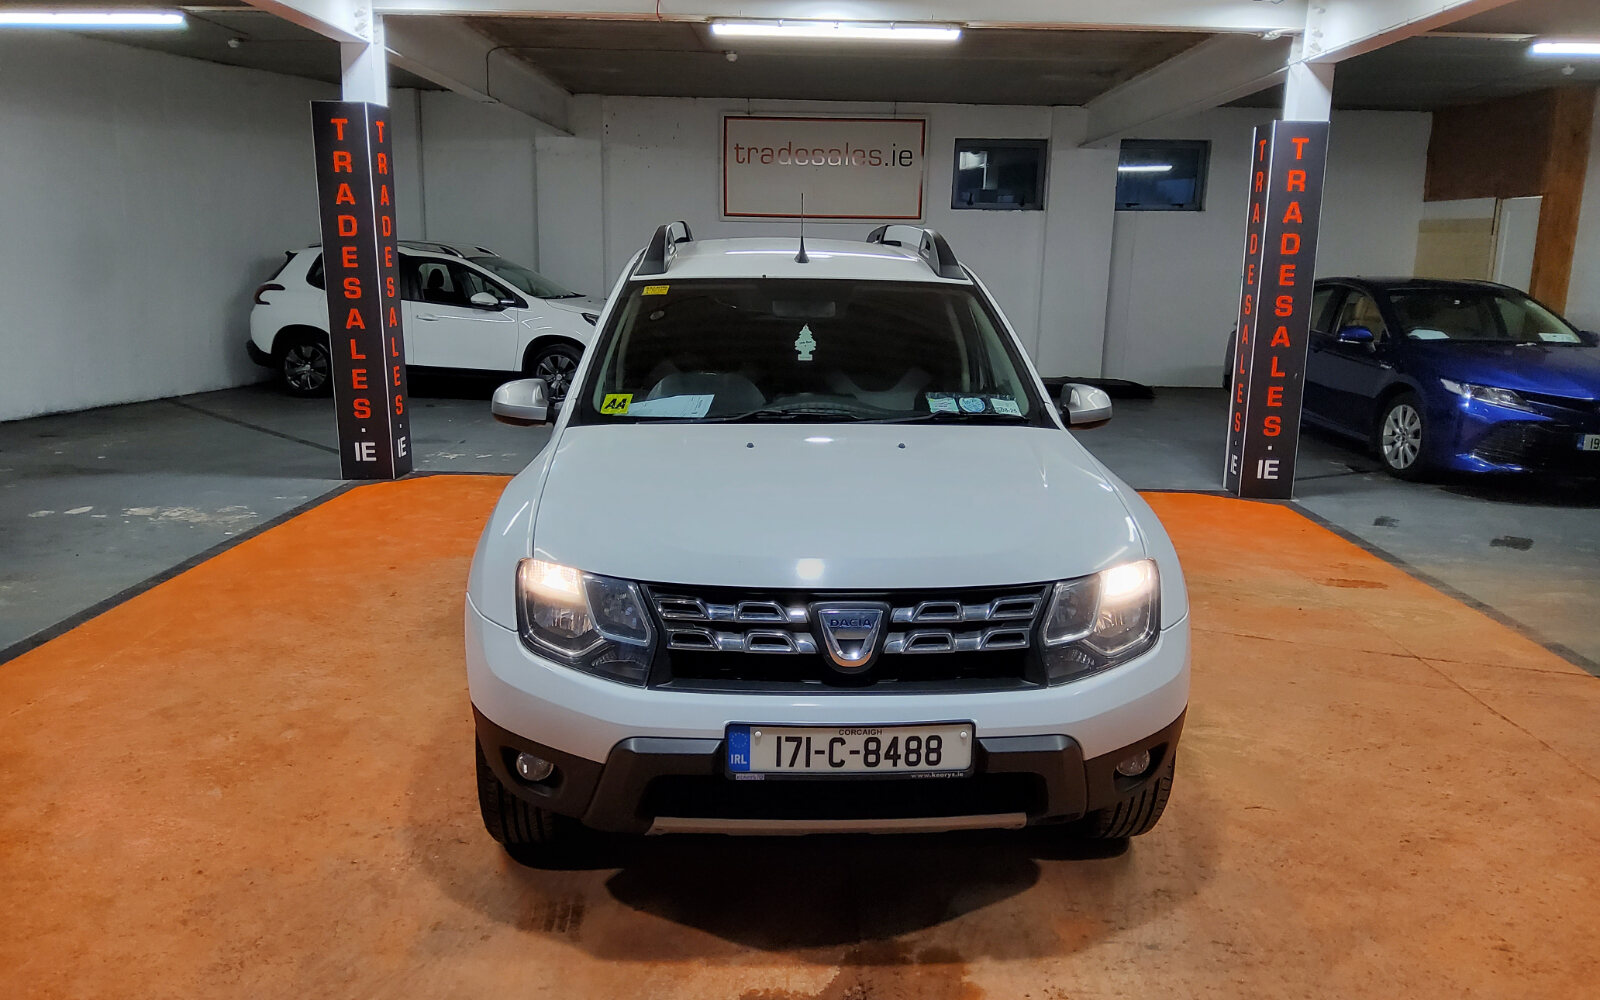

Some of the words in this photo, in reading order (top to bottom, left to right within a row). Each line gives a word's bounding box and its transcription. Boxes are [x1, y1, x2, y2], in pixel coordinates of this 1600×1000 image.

[734, 141, 913, 167] tradesales.ie
[604, 398, 627, 410] AA
[829, 618, 872, 629] DACIA
[838, 728, 883, 736] CORCAIGH
[775, 735, 943, 768] 171-C-8488
[730, 753, 748, 765] IRL
